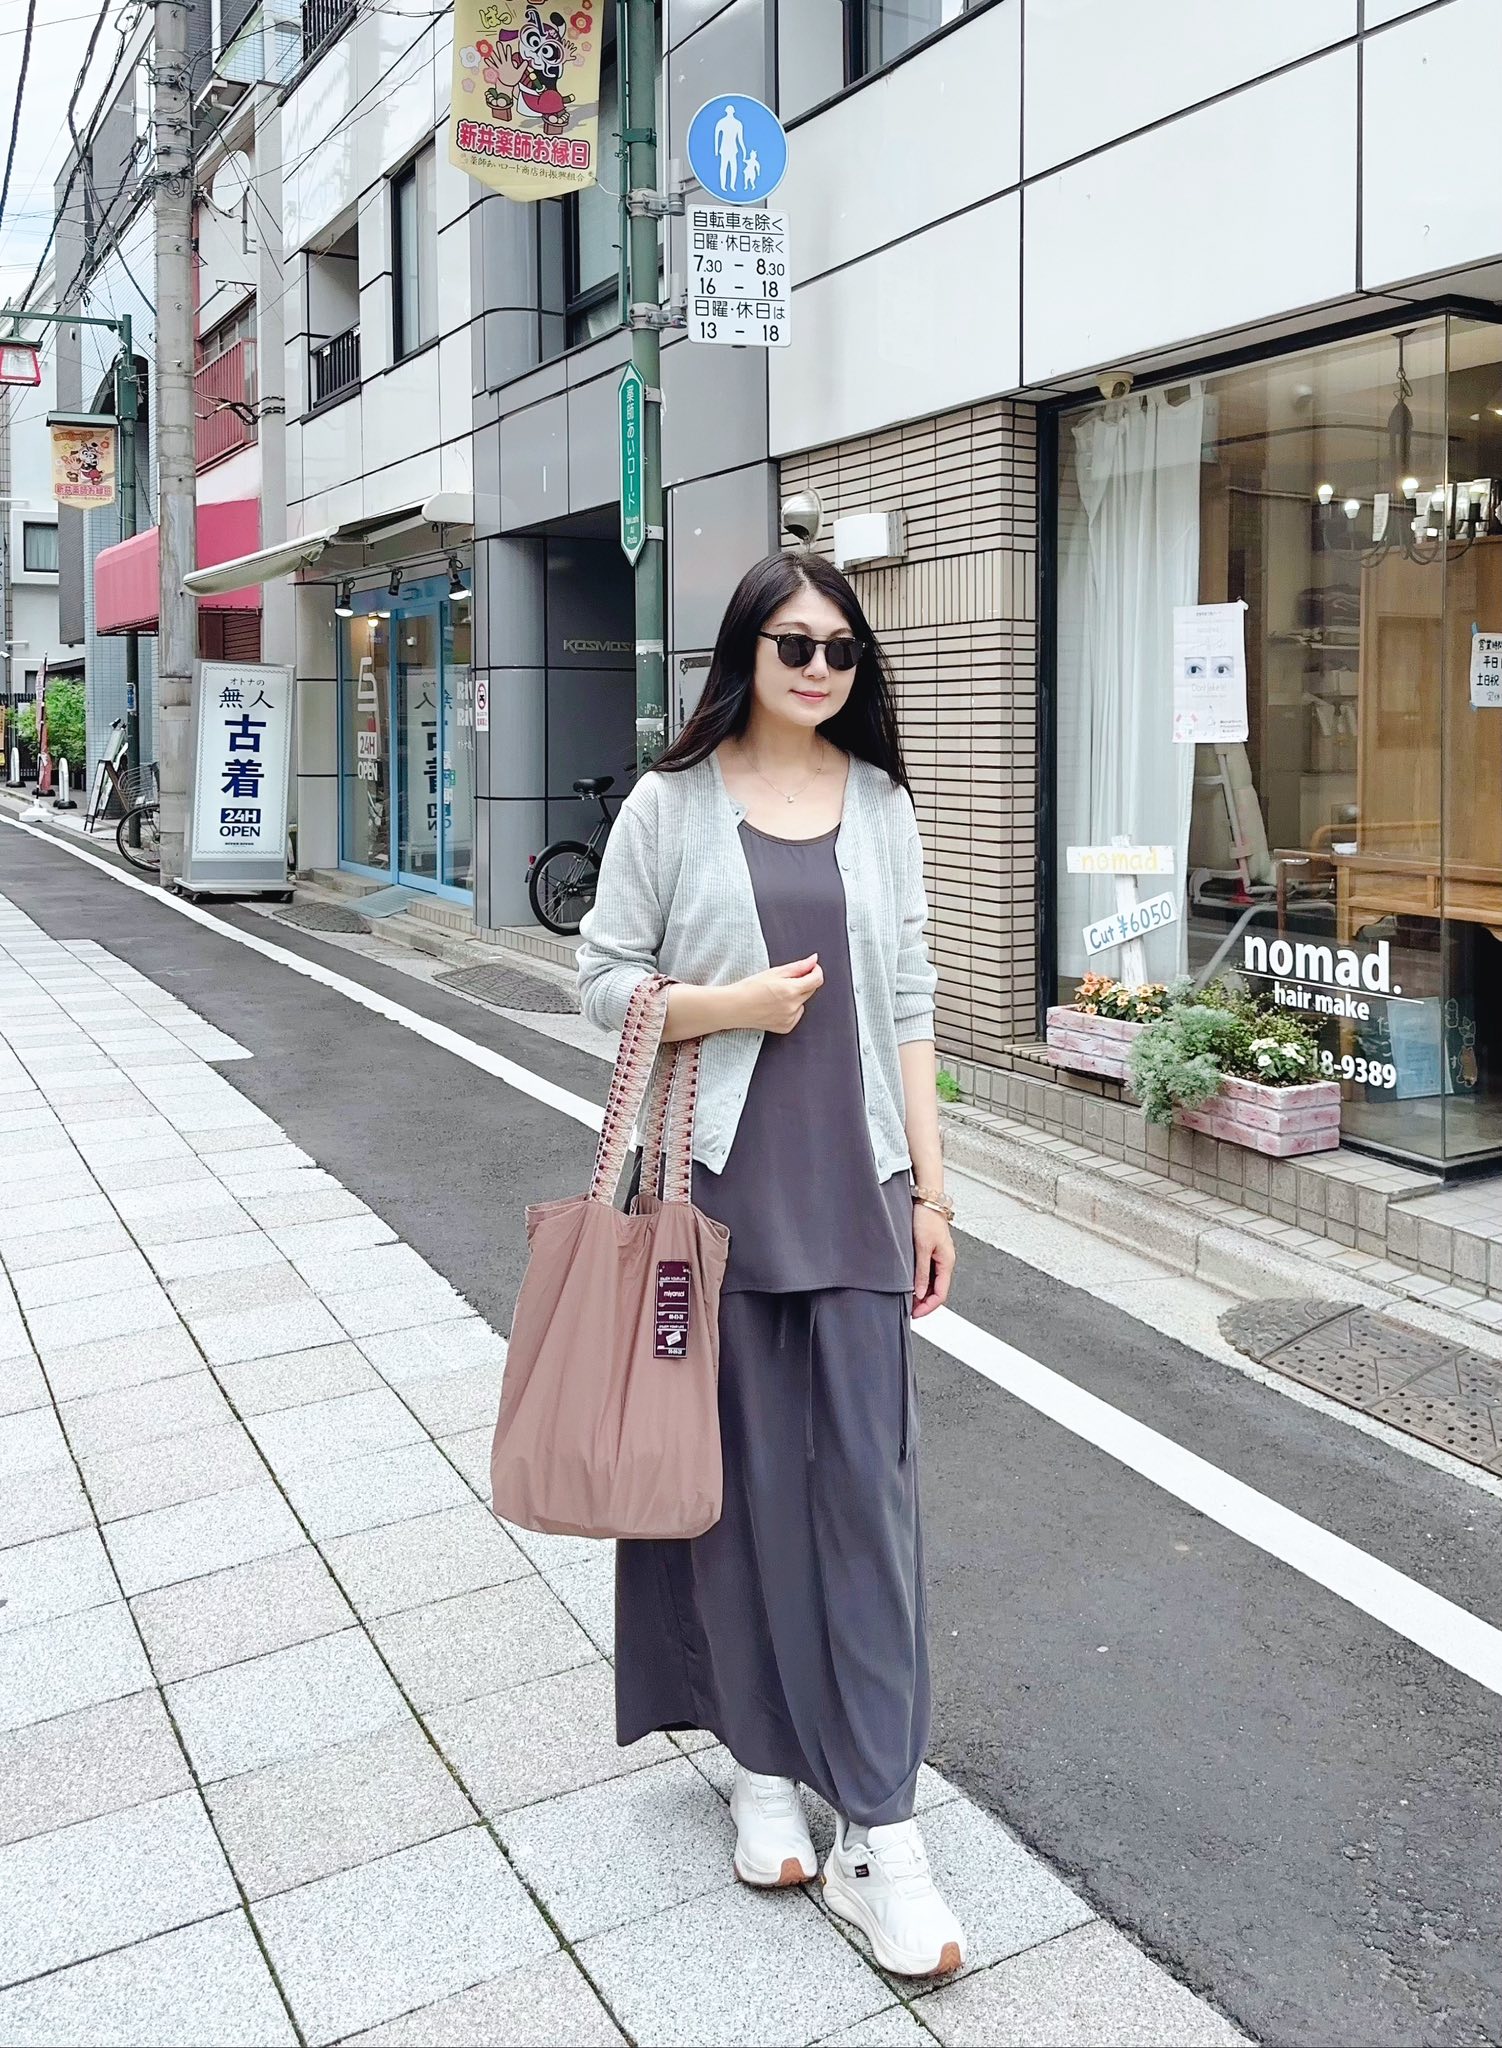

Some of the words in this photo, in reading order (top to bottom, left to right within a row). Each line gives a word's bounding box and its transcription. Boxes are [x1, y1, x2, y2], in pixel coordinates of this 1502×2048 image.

[457, 119, 591, 169] 新井薬師お縁日
[693, 210, 784, 232] 自転車を除く
[693, 254, 723, 273] 7.30
[756, 258, 785, 276] 8.30
[700, 277, 716, 295] 16
[762, 280, 779, 298] 18
[695, 299, 785, 320] 日曜・休日は
[700, 321, 717, 339] 13
[763, 324, 779, 342] 18
[625, 384, 637, 512] 薬師あいロード
[564, 639, 635, 654] KOSMOS
[229, 676, 265, 687] オトナの
[218, 686, 275, 709] 無人
[221, 713, 267, 798] 古着
[359, 734, 376, 756] 24H
[358, 760, 378, 781] OPEN
[222, 808, 259, 823] 24H
[219, 825, 261, 837] OPEN
[1089, 925, 1115, 949] Cut
[1117, 899, 1172, 939] ¥6050
[1274, 981, 1312, 1009] hair
[1314, 994, 1370, 1021] make
[1313, 1048, 1398, 1090] 8-9389
